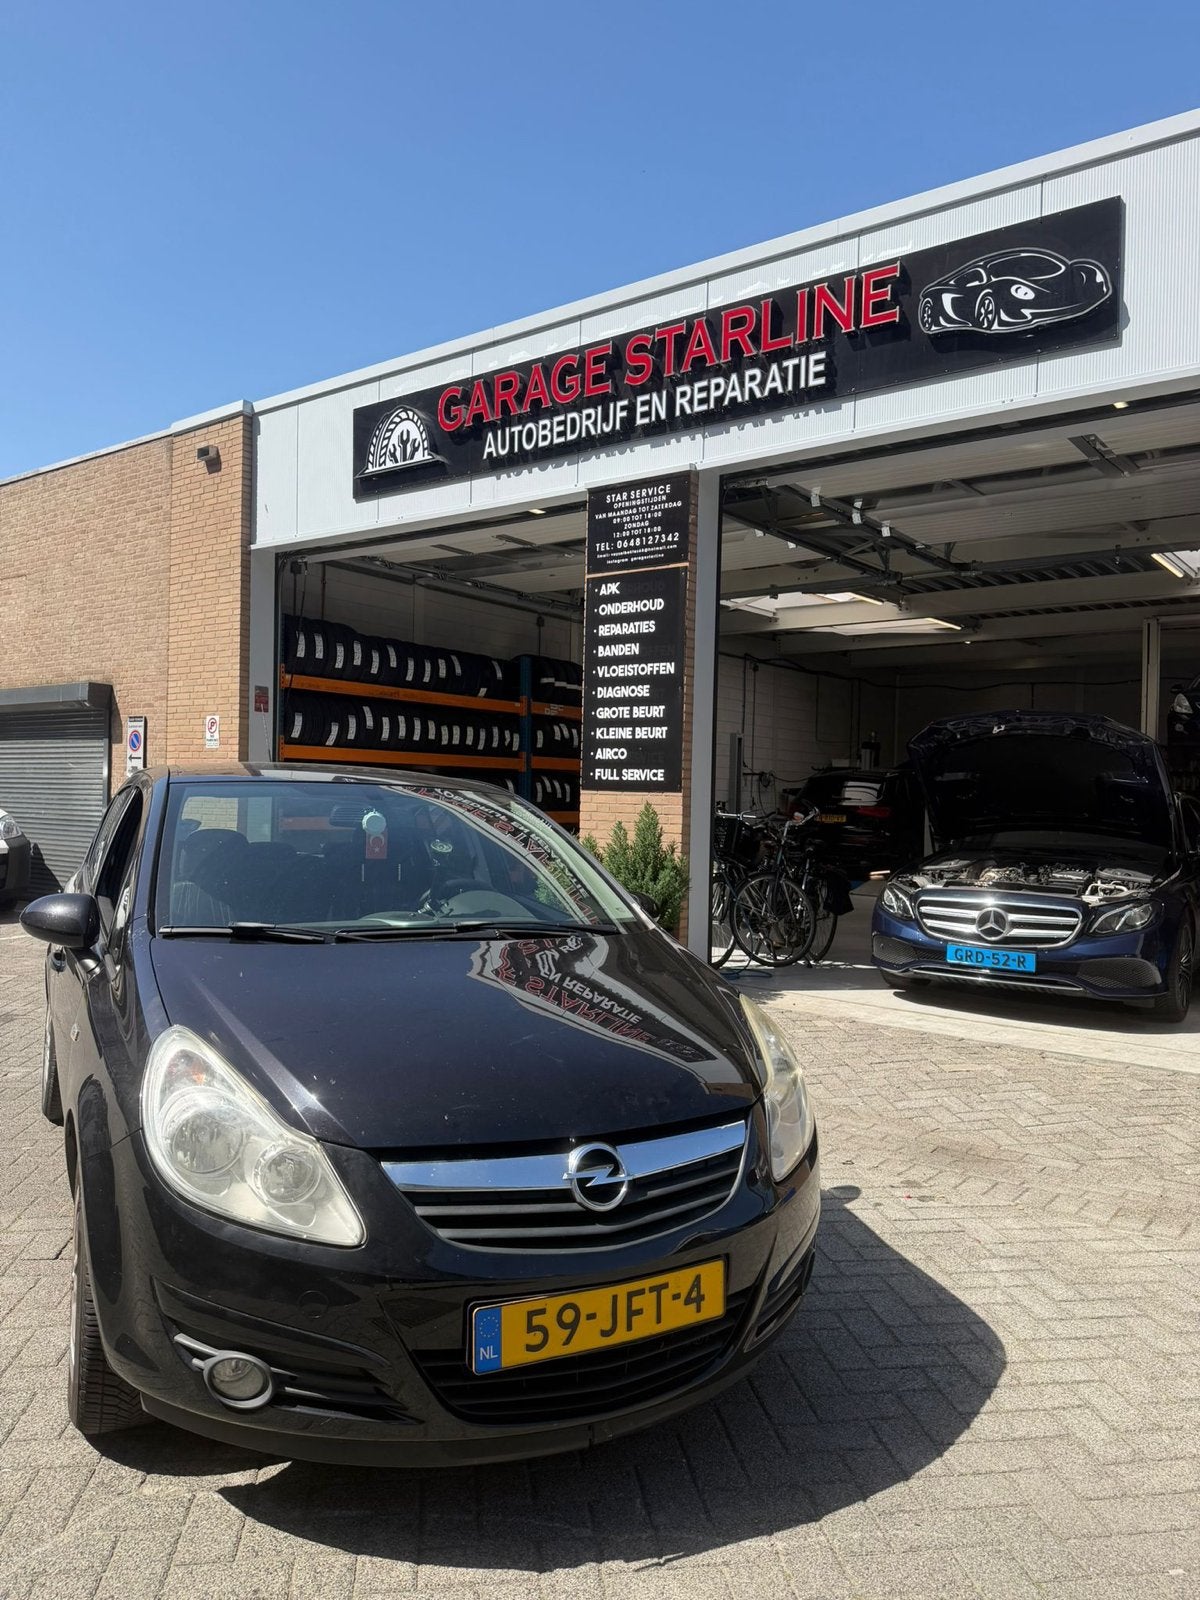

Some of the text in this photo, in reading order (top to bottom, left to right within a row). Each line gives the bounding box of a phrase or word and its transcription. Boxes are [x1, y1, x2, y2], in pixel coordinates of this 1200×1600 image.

[438, 261, 900, 433] GARAGE STARLINE
[482, 350, 827, 461] AUTOBEDRIJF EN REPARATIE
[605, 484, 671, 504] STAR SERVICE
[613, 494, 667, 509] OPENINGSTIJDEN
[595, 500, 682, 520] VAN MAANDAG TOT ZATERDAG
[631, 513, 643, 521] TOT
[624, 520, 650, 530] ZONDAG
[595, 532, 680, 552] TEL: 0648127342
[599, 581, 621, 596] APK
[598, 598, 665, 616] ONDERHOUD
[598, 620, 656, 637] REPARATIES
[597, 643, 640, 658] BANDEN
[597, 661, 675, 678] VLOEISTOFFEN
[597, 684, 650, 699] DIAGNOSE
[596, 705, 666, 719] GROTE BEURT
[595, 726, 668, 740] KLEINE BEURT
[595, 748, 628, 760] AIRCO
[595, 768, 665, 781] FULL SERVICE
[954, 948, 1027, 969] GRD-52-R
[479, 1274, 705, 1361] NL 59-JFT-4
